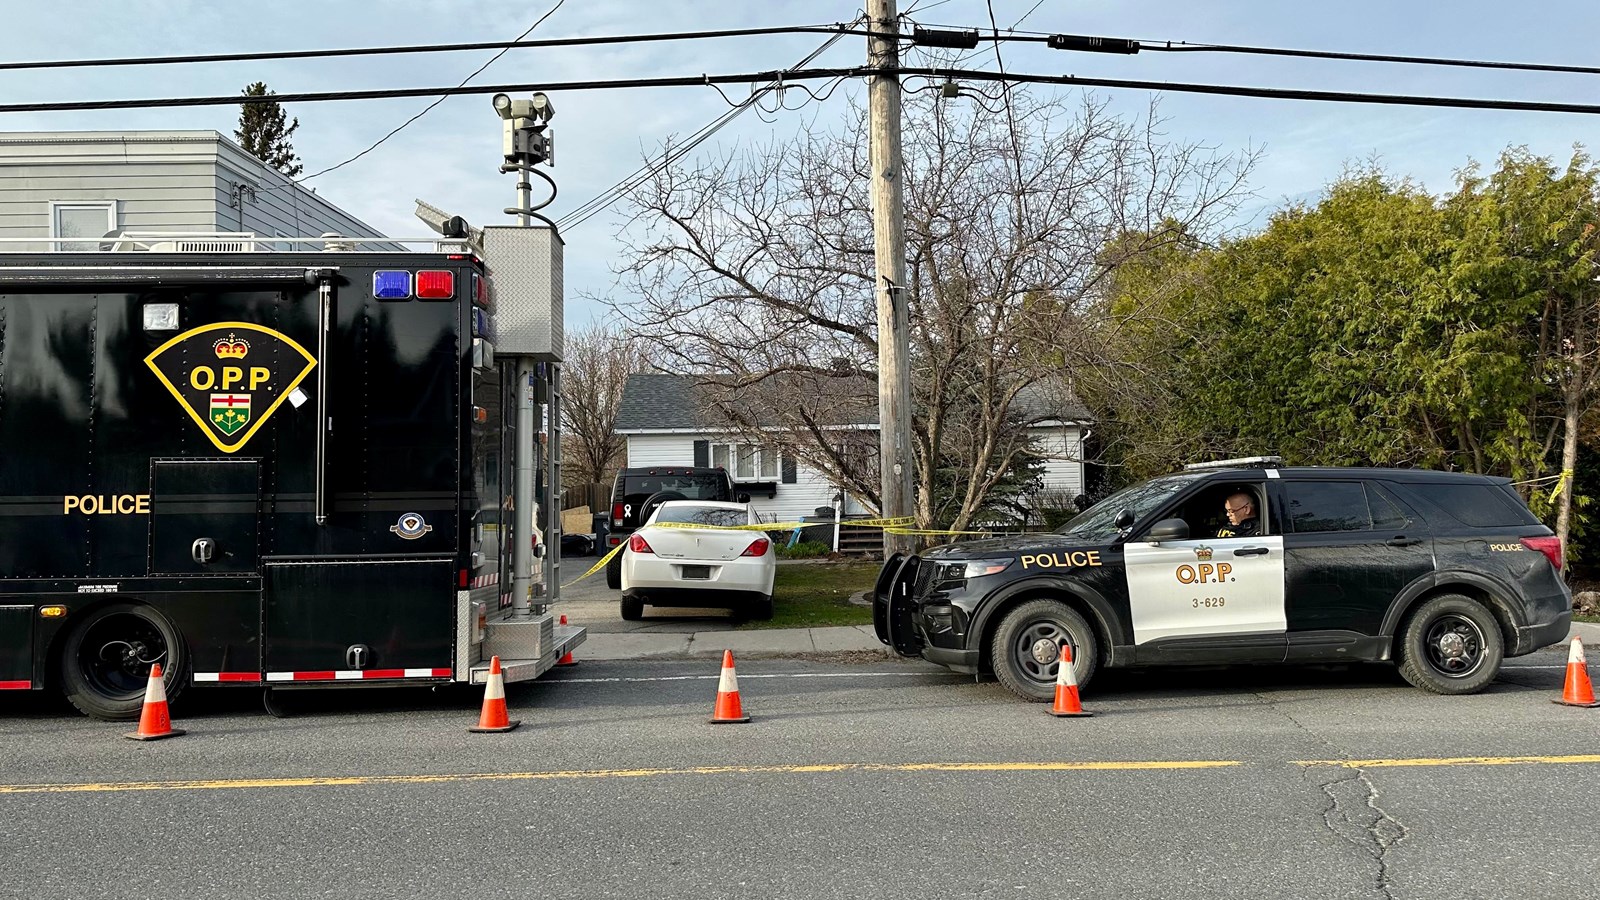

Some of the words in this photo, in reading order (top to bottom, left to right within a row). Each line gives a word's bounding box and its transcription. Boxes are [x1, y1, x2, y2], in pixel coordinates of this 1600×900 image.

[190, 365, 272, 390] O.P.P.
[64, 494, 150, 515] POLICE
[1490, 543, 1523, 552] POLICE
[1020, 550, 1102, 569] POLICE
[1175, 562, 1236, 584] O.P.P.
[1192, 597, 1225, 608] 3-629
